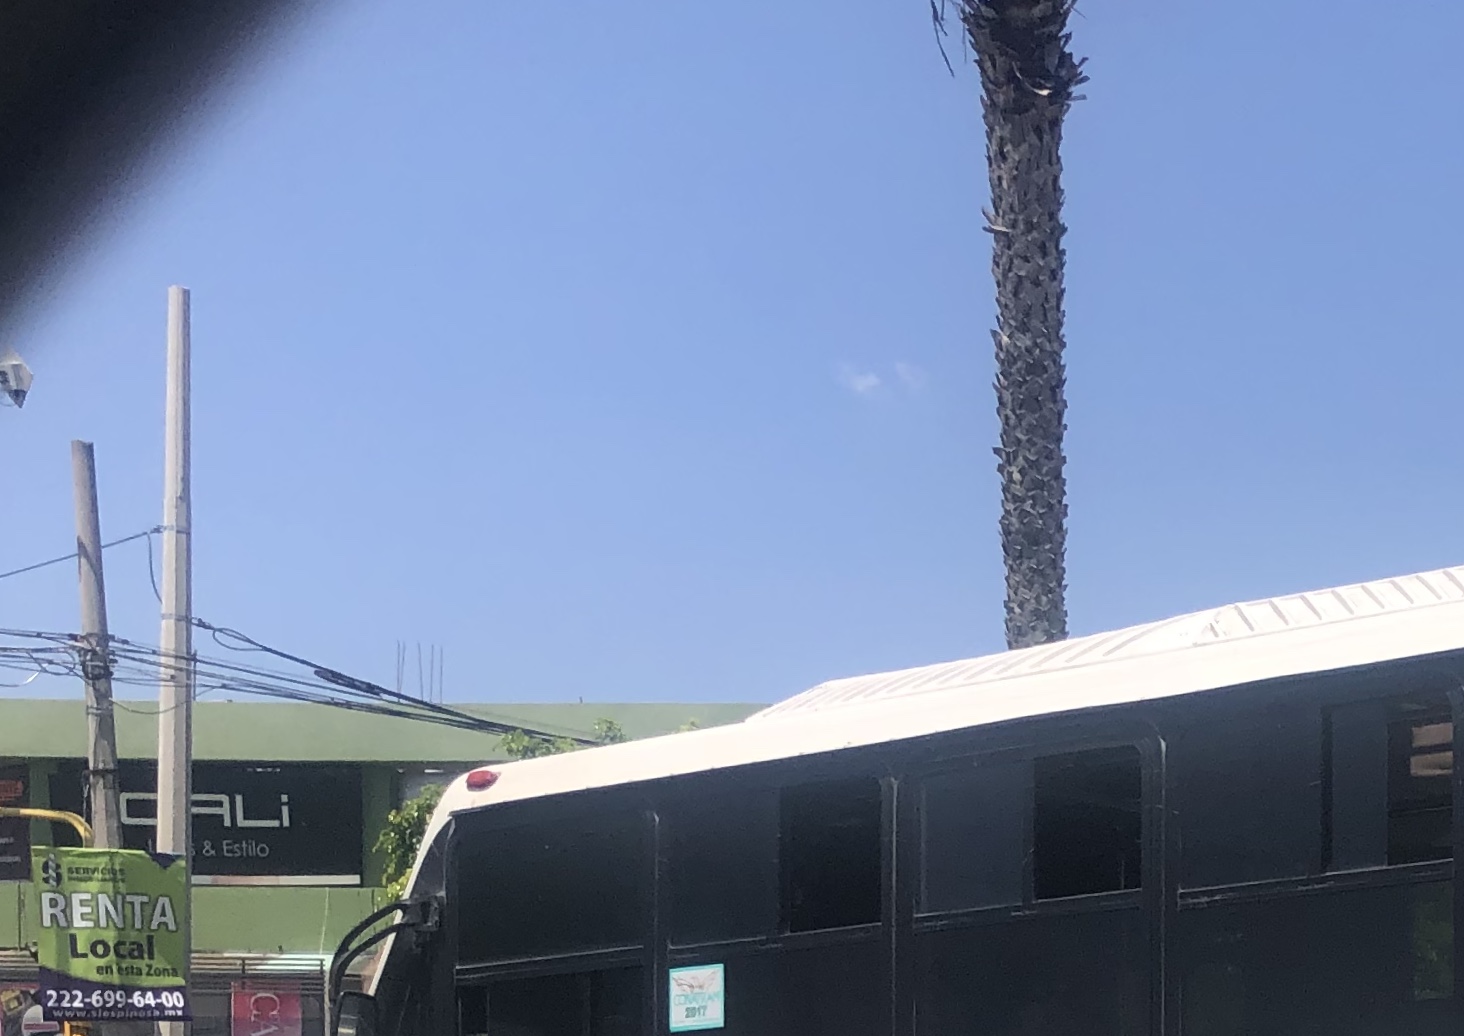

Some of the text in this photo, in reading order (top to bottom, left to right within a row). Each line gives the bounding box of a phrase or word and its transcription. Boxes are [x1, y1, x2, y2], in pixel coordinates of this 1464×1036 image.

[202, 840, 216, 857] &
[222, 839, 270, 857] Estilo
[40, 891, 178, 933] RENTA
[68, 932, 156, 961] Local
[96, 964, 180, 978] en esta Zona
[46, 989, 185, 1009] 222-699-64-00
